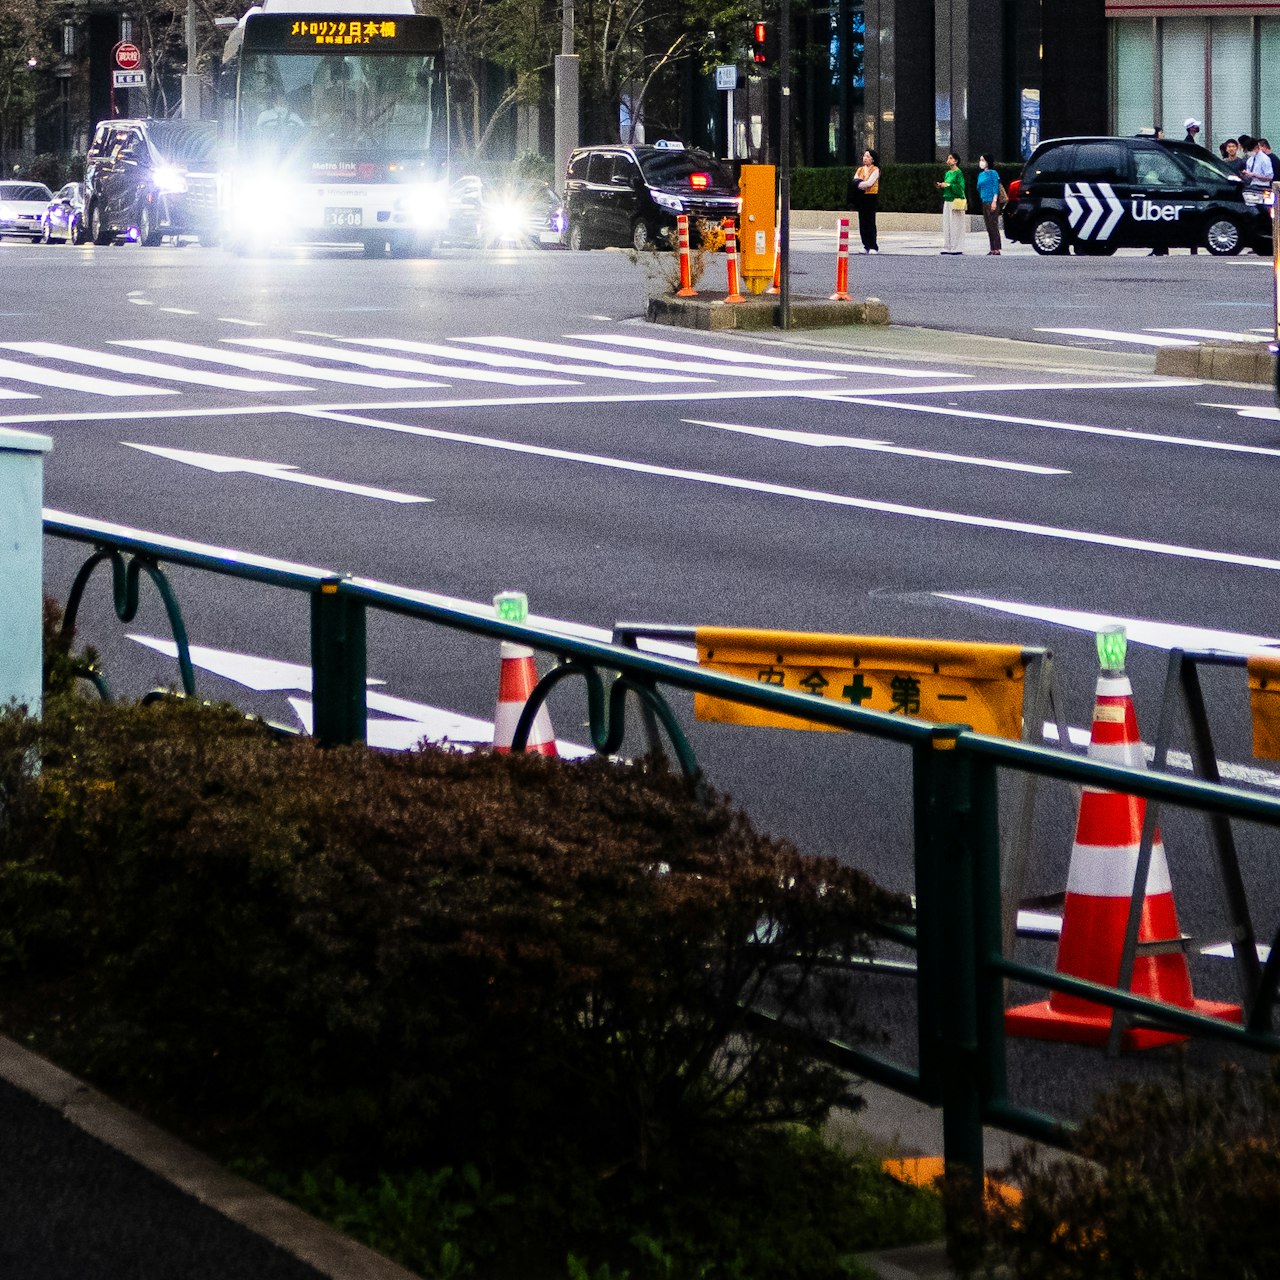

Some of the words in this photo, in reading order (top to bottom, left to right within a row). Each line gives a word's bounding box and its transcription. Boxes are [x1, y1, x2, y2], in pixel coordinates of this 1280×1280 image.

[331, 213, 361, 225] 36-08
[1131, 200, 1183, 221] Uber
[889, 675, 968, 715] 第一
